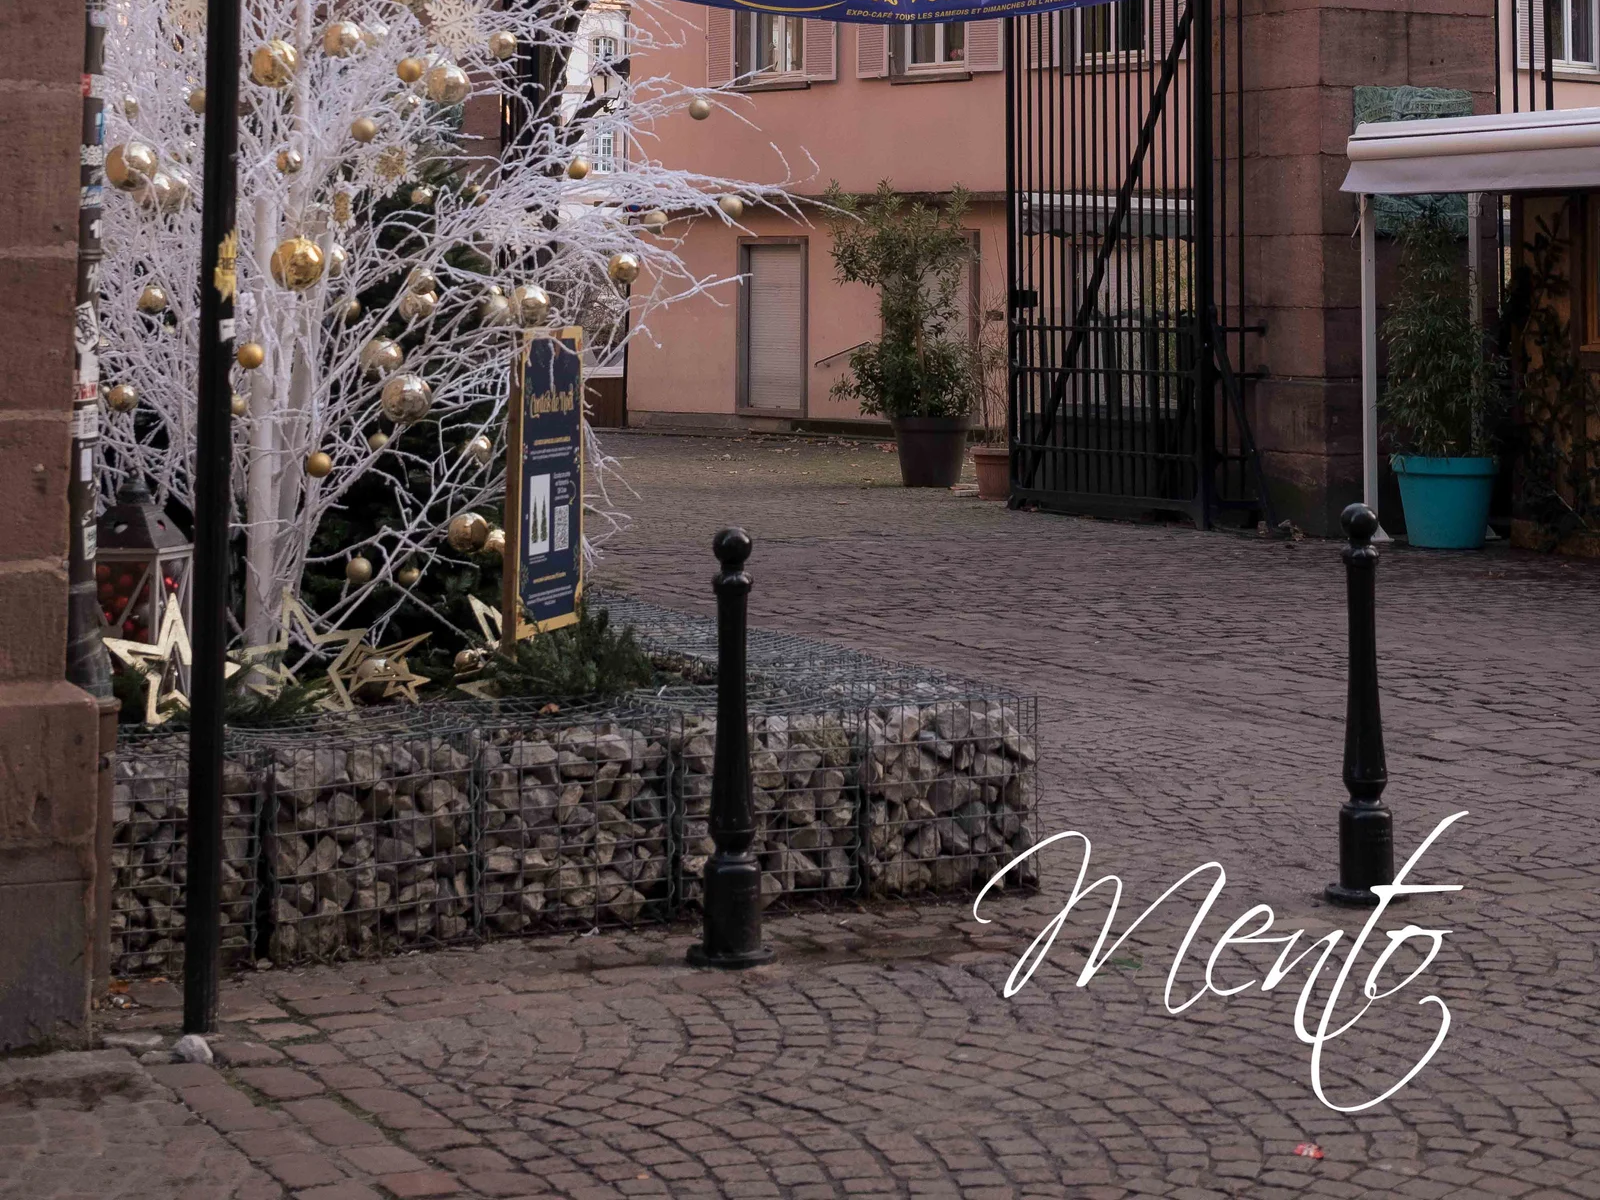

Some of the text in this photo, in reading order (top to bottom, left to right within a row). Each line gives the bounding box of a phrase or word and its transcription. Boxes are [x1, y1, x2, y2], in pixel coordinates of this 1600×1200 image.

[846, 8, 893, 19] EXPO-CAFÉ
[894, 13, 916, 21] TOUS
[918, 12, 933, 20] LES
[934, 8, 969, 18] SAMEDIS
[971, 7, 981, 15] ET
[983, 0, 1026, 13] DIMANCHES
